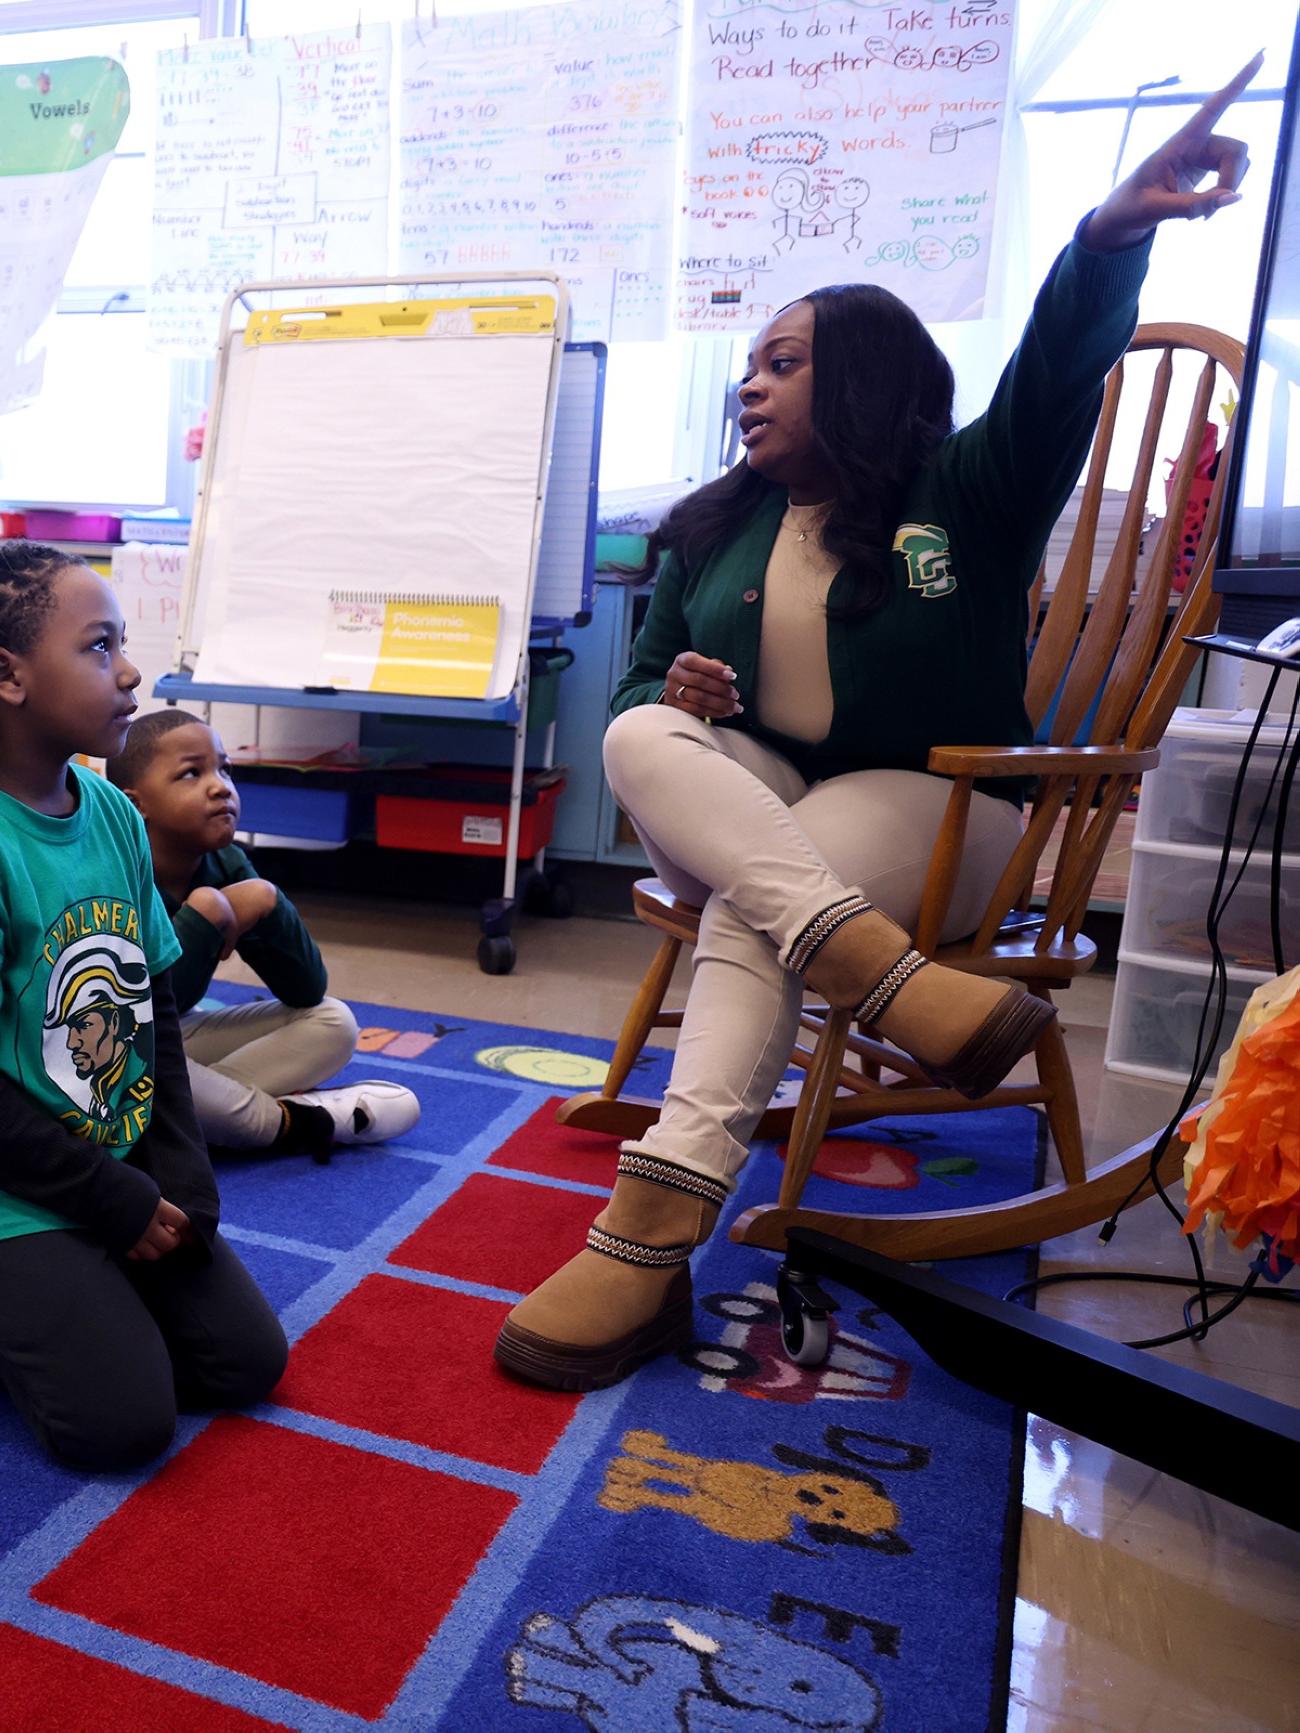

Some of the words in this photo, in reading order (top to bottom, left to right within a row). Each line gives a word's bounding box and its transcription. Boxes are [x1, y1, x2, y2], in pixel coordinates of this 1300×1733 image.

[883, 8, 933, 30] Take
[445, 10, 531, 53] Math
[709, 22, 764, 53] Ways
[780, 20, 797, 38] to
[807, 20, 830, 37] do
[840, 17, 858, 35] it
[554, 59, 594, 74] value
[716, 57, 773, 80] Read
[790, 52, 874, 89] together
[29, 98, 91, 119] Vowels
[453, 105, 464, 119] 3
[478, 103, 498, 118] 10
[570, 94, 603, 112] 376
[710, 111, 743, 130] You
[750, 112, 783, 125] can
[794, 106, 834, 121] also
[844, 99, 886, 123] help
[897, 101, 932, 120] your
[754, 140, 821, 165] tricky
[475, 157, 493, 170] 10
[722, 174, 739, 183] on
[690, 206, 716, 219] soft
[724, 210, 757, 220] voices
[911, 215, 935, 232] you
[942, 210, 979, 223] read
[424, 249, 449, 265] 57
[550, 247, 581, 262] 172
[679, 255, 722, 269] Where
[728, 254, 742, 268] to
[748, 253, 768, 268] sit
[393, 612, 465, 628] Phonemic
[392, 627, 471, 643] Awareness
